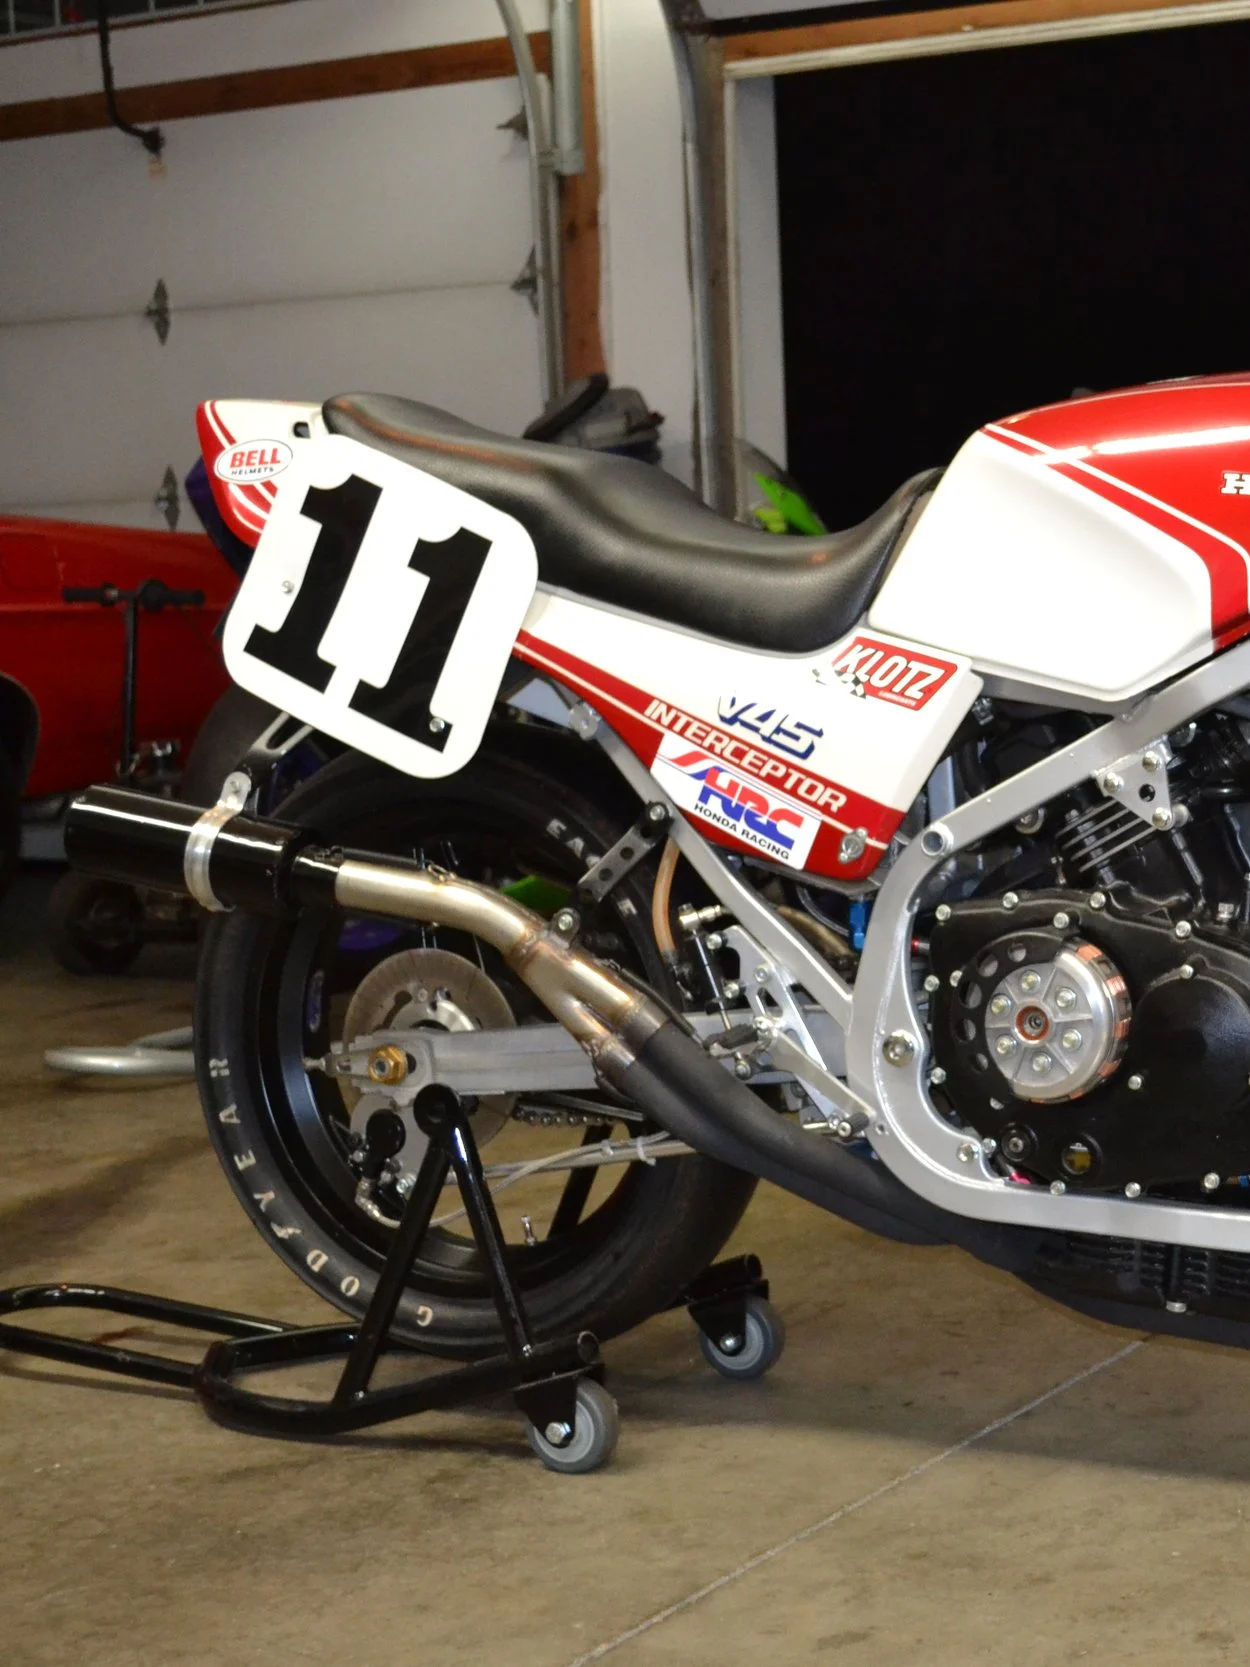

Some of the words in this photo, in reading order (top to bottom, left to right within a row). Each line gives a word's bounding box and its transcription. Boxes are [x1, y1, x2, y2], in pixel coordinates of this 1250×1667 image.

[230, 448, 281, 469] BELL
[231, 467, 274, 476] HELMETS
[243, 473, 493, 754] 11
[833, 644, 946, 700] KLOTZ
[644, 699, 847, 812] INTERCEPTOR
[717, 694, 824, 760] V45
[694, 803, 737, 832] HONDA
[741, 829, 790, 860] RACING
[698, 767, 805, 850] HRC
